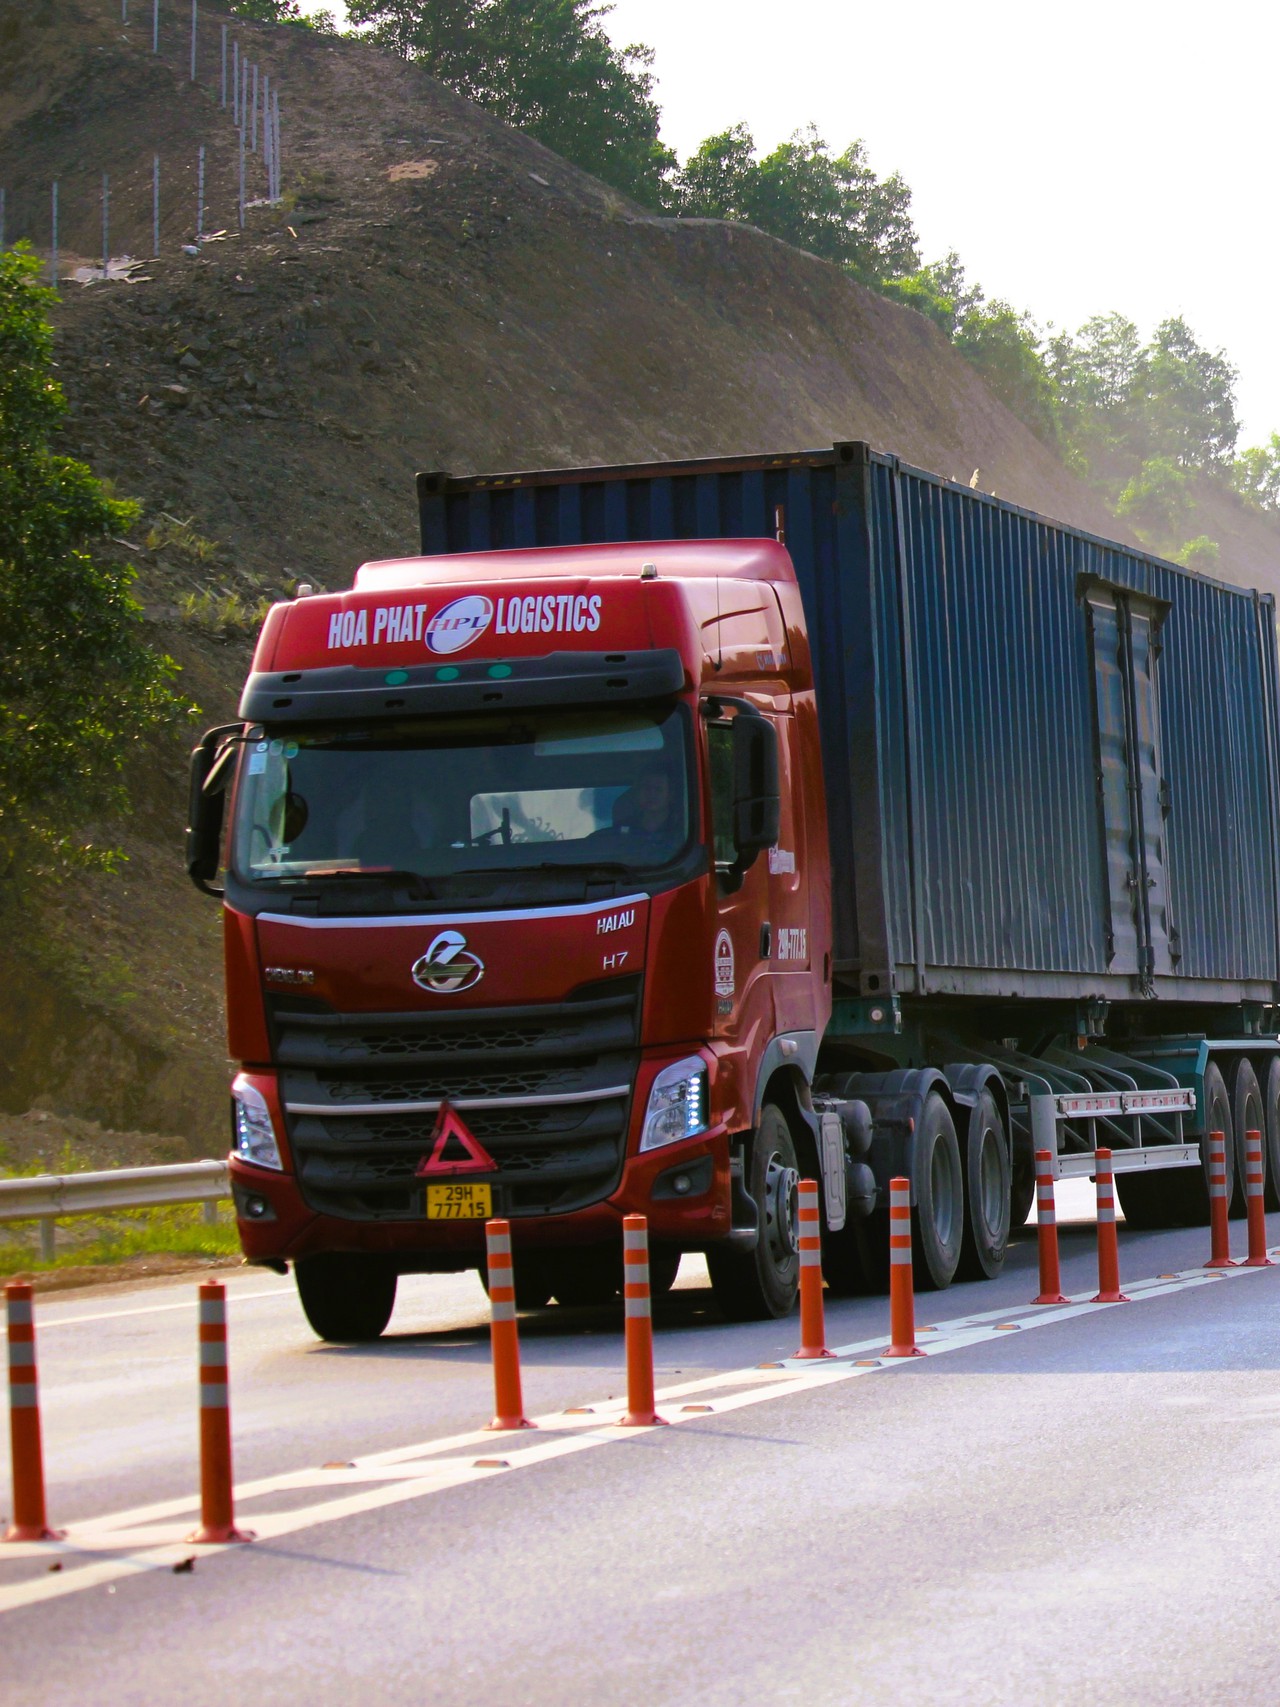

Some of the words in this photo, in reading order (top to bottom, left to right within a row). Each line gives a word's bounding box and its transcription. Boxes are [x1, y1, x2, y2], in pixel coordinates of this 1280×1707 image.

[495, 595, 602, 634] LOGISTICS
[327, 609, 368, 649] HOA
[373, 604, 427, 644] PHAT
[430, 616, 488, 631] HPL
[603, 951, 629, 970] H7
[445, 1186, 472, 1201] 29H
[434, 1202, 486, 1217] 777.15
